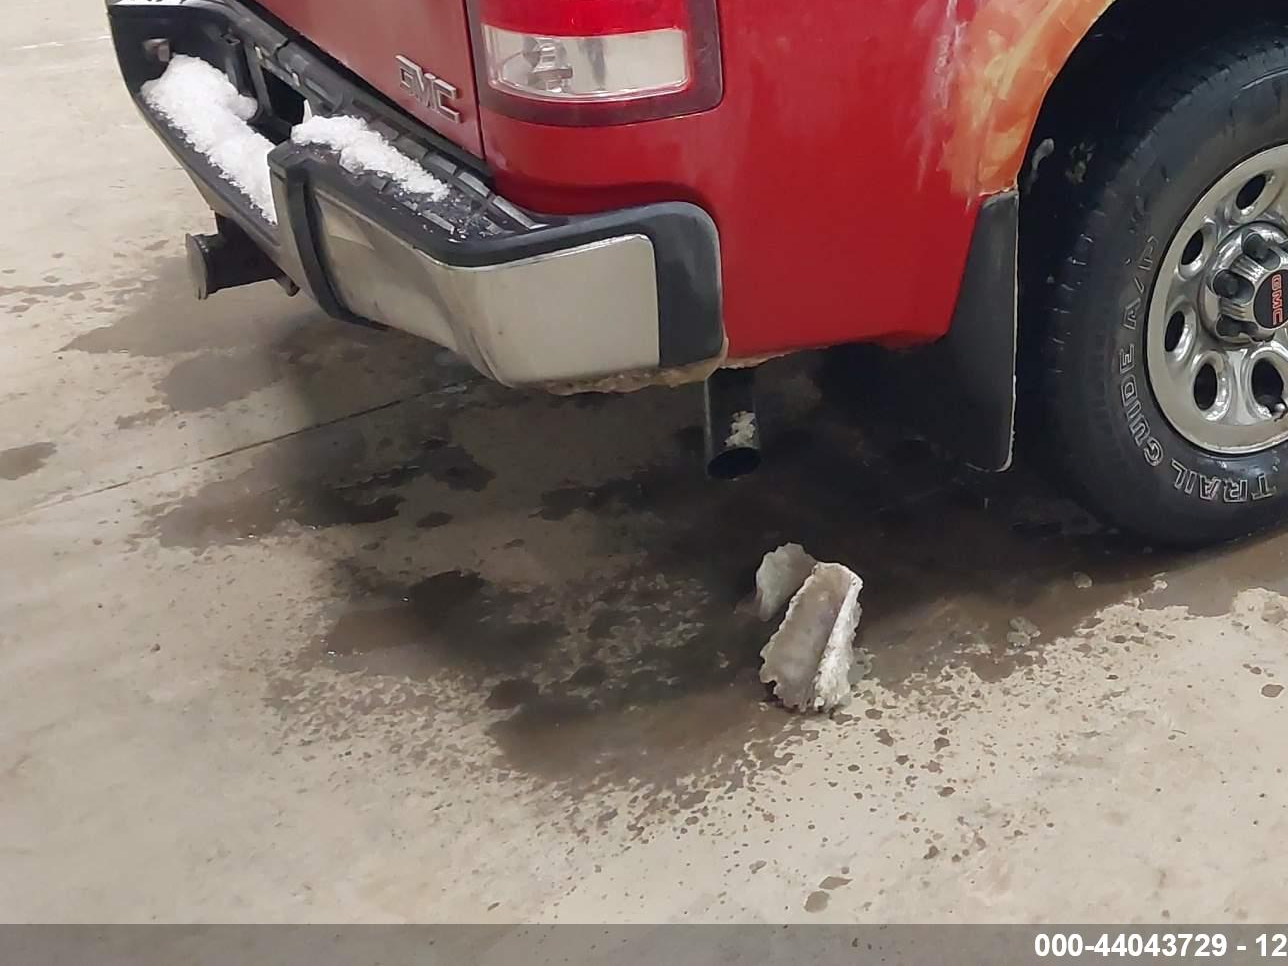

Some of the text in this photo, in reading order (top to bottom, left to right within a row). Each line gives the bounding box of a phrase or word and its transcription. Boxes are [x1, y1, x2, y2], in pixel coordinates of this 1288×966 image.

[395, 54, 460, 123] GMC
[1271, 273, 1284, 326] GMC
[1119, 342, 1165, 468] GUIDE
[1170, 456, 1277, 503] TRAIL
